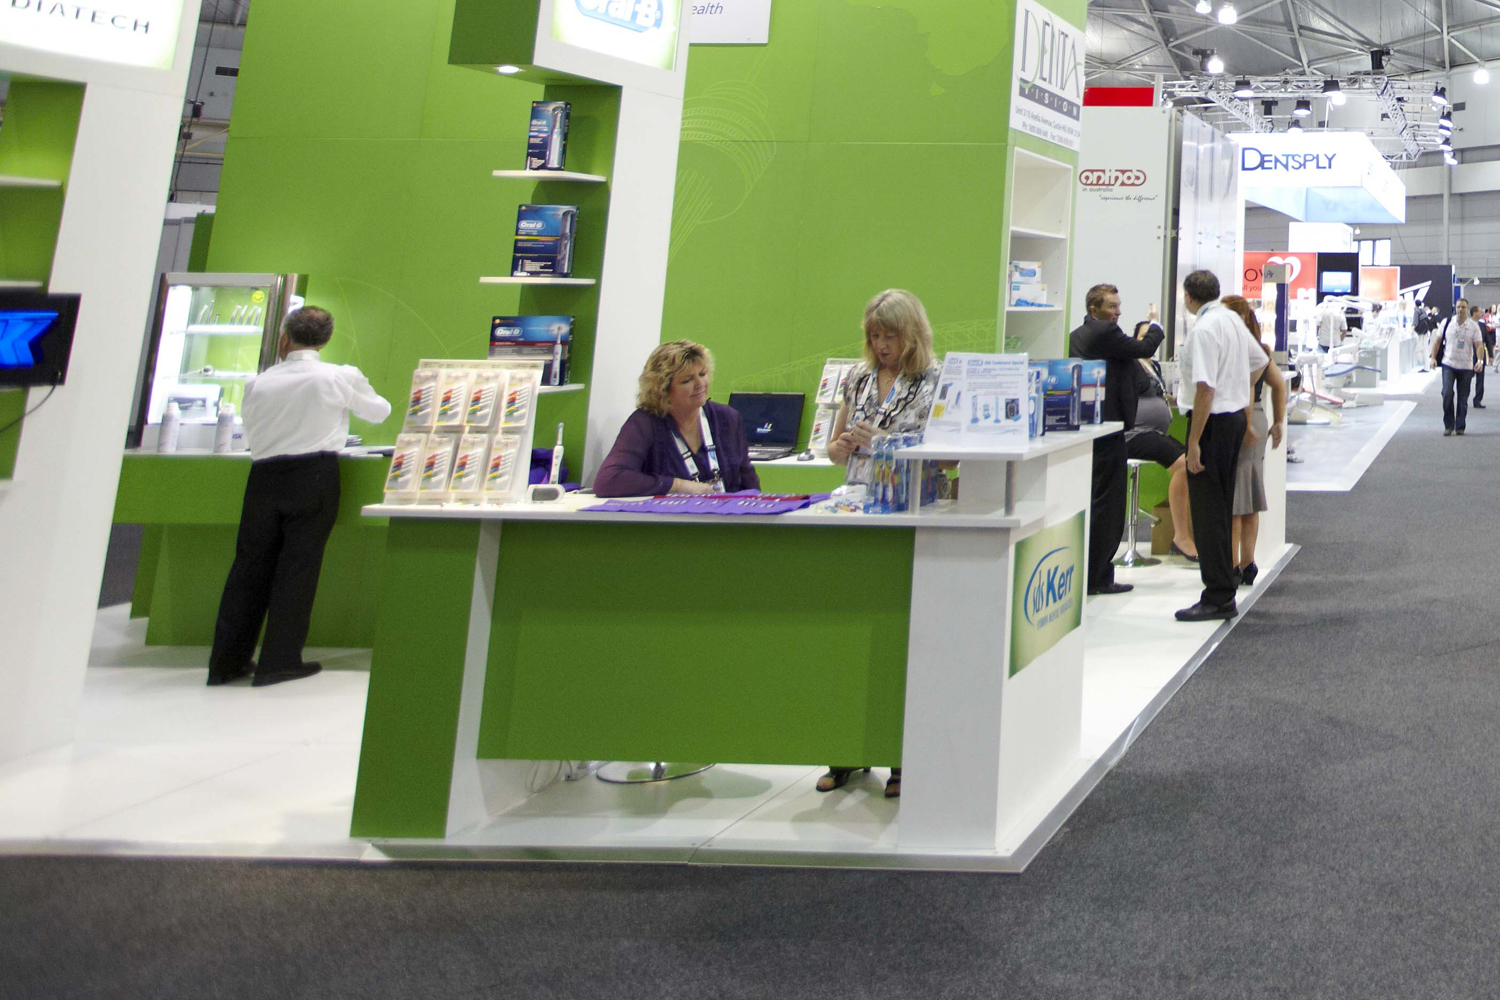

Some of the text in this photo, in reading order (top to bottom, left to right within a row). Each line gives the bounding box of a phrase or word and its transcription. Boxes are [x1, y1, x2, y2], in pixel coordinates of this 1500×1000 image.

[692, 2, 724, 15] ealth
[1018, 8, 1082, 99] DENTA
[1024, 86, 1078, 117] VISION
[1241, 147, 1337, 172] DENTSPLY
[1045, 563, 1075, 609] Kerr
